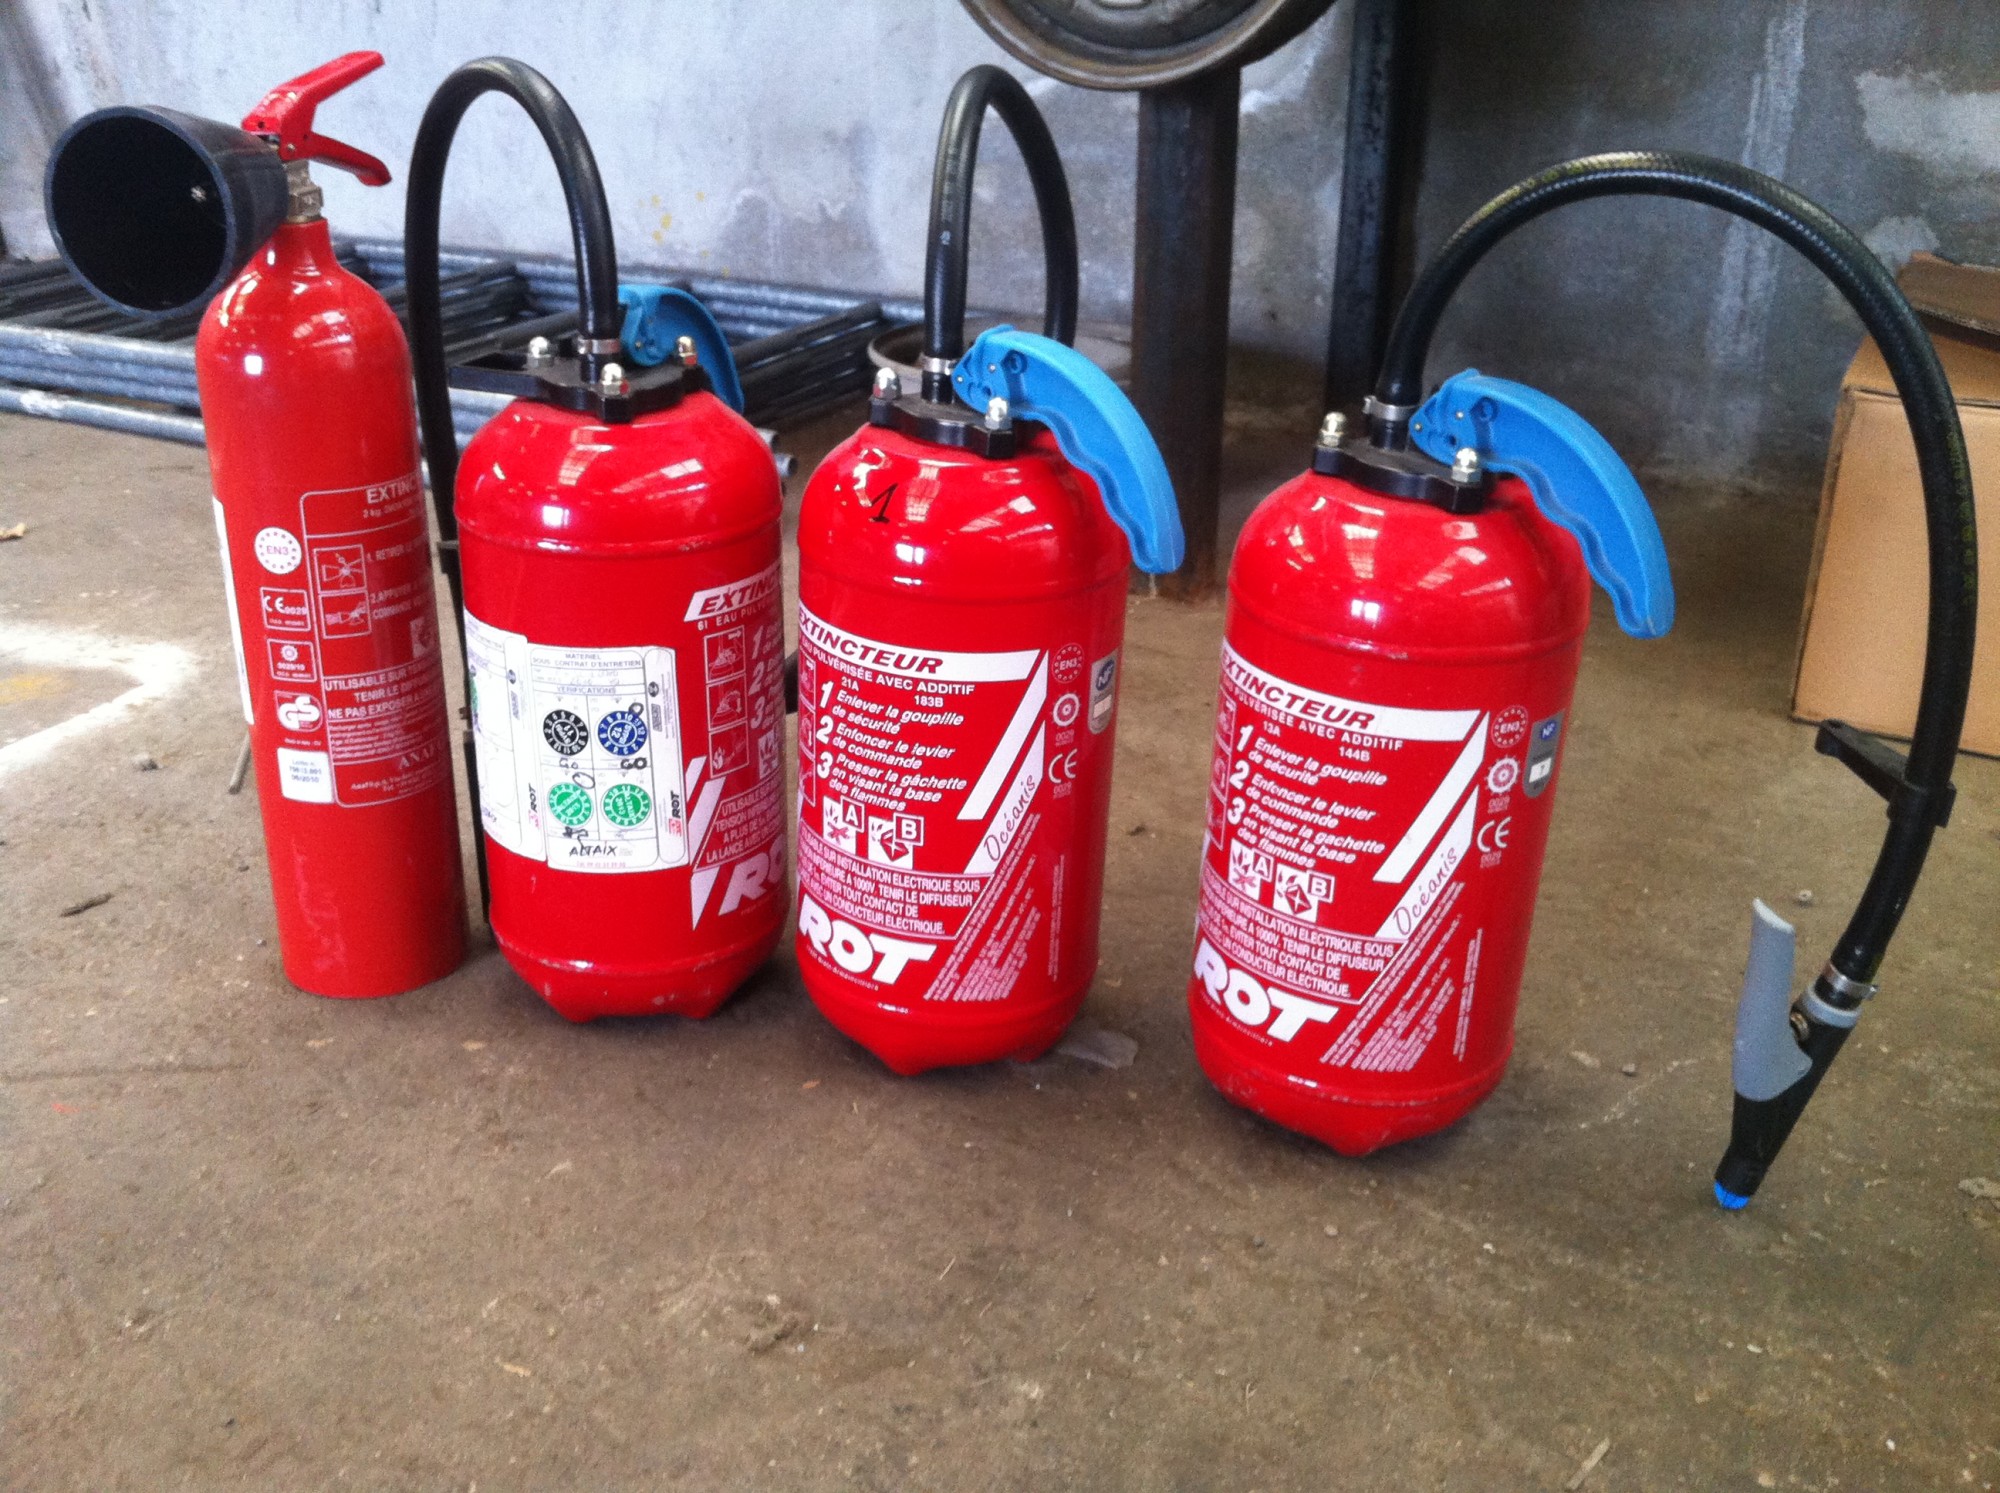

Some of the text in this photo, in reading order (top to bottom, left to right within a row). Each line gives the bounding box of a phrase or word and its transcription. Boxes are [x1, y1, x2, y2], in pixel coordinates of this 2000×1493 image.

[871, 483, 898, 524] 1
[266, 544, 289, 555] EN3
[716, 612, 737, 626] EAU
[752, 625, 763, 659] 1
[748, 661, 765, 696] 2
[1059, 658, 1078, 671] EN3
[325, 673, 386, 691] UTILISABLE
[353, 688, 385, 702] TENIR
[841, 676, 859, 691] 21A
[876, 674, 913, 690] AVEC
[916, 682, 976, 695] ADDITIF
[328, 708, 343, 719] NE
[345, 705, 367, 718] PAS
[368, 695, 413, 715] EXPOSER
[751, 696, 765, 729] 3
[820, 681, 964, 727] 1 Enlever la goupille
[914, 695, 944, 708] 183B
[816, 715, 956, 759] 2 Enfoncer le levier
[832, 705, 901, 735] de sécurité
[1263, 721, 1281, 737] 13A
[1299, 720, 1336, 739] AVEC
[1341, 732, 1404, 750] ADDITIF
[832, 736, 923, 770] de commande
[1048, 748, 1078, 783] CE
[1236, 725, 1388, 786] 1 Enlever la goupille
[1248, 751, 1319, 786] de sécurité
[1339, 746, 1370, 762] 144B
[817, 751, 968, 790] 3 Presser la gâchette
[832, 767, 943, 803] en visant la base
[829, 778, 906, 812] des flammes
[1229, 760, 1376, 821] 2 Enfoncer le levier
[715, 811, 747, 832] TENSION
[845, 804, 858, 826] A
[983, 774, 1036, 862] Océanis
[1227, 797, 1246, 825] 3
[1249, 803, 1298, 832] Presser
[1298, 825, 1313, 839] la
[1246, 787, 1339, 829] de commande
[723, 832, 730, 844] A
[902, 820, 918, 839] B
[1242, 817, 1357, 864] en visant la base
[1477, 816, 1512, 853] CE
[706, 851, 718, 864] LA
[718, 841, 744, 860] LANCE
[1238, 827, 1316, 868] des flammes
[837, 853, 891, 885] INSTALLATION
[893, 869, 951, 891] ELECTRIQUE
[953, 880, 980, 892] SOUS
[1254, 859, 1268, 877] A
[842, 885, 862, 903] TOUT
[863, 892, 904, 916] CONTACT
[905, 904, 919, 918] DE
[846, 873, 852, 885] A
[878, 884, 904, 901] TENIR
[906, 889, 918, 903] LE
[921, 891, 973, 907] DIFFUSEUR
[1312, 877, 1327, 896] B
[1393, 846, 1458, 937] Océanis
[832, 895, 884, 924] CONDUCTEUR
[799, 893, 938, 985] ROT
[1248, 922, 1254, 935] A
[1283, 938, 1309, 957] TENIR
[1311, 945, 1324, 960] LE
[1327, 949, 1385, 972] DIFFUSEUR
[1299, 926, 1362, 953] ELECTRIQUE
[1364, 944, 1393, 958] SOUS
[1232, 940, 1285, 980] CONDUCTEUR
[1256, 941, 1278, 961] TOUT
[1279, 950, 1326, 978] CONTACT
[1326, 966, 1341, 980] DE
[1194, 937, 1339, 1042] ROT
